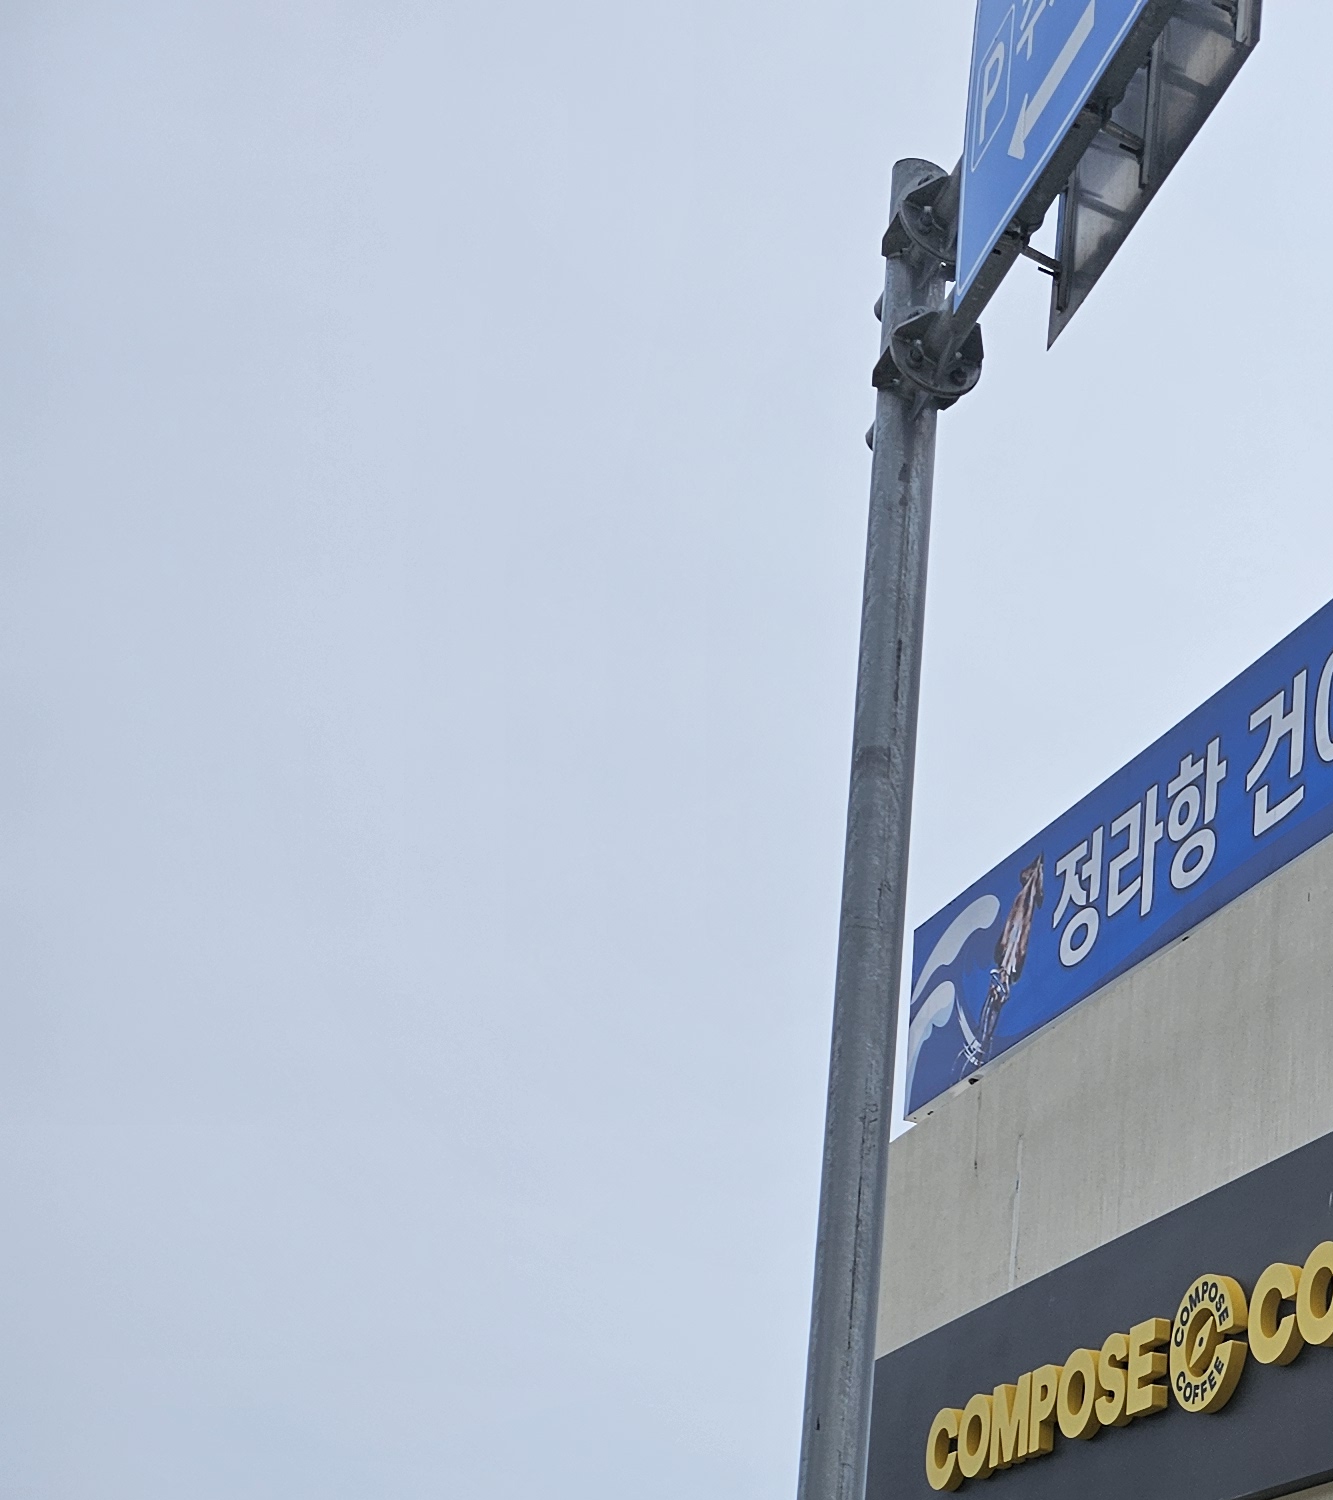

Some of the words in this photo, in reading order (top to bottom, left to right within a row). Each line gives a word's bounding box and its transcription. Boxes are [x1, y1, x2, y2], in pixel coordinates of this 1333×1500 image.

[1051, 735, 1228, 969] 정라항
[1173, 1280, 1229, 1348] COMPOSE
[925, 1317, 1171, 1492] COMPOSE
[1175, 1357, 1226, 1406] COFFEE
